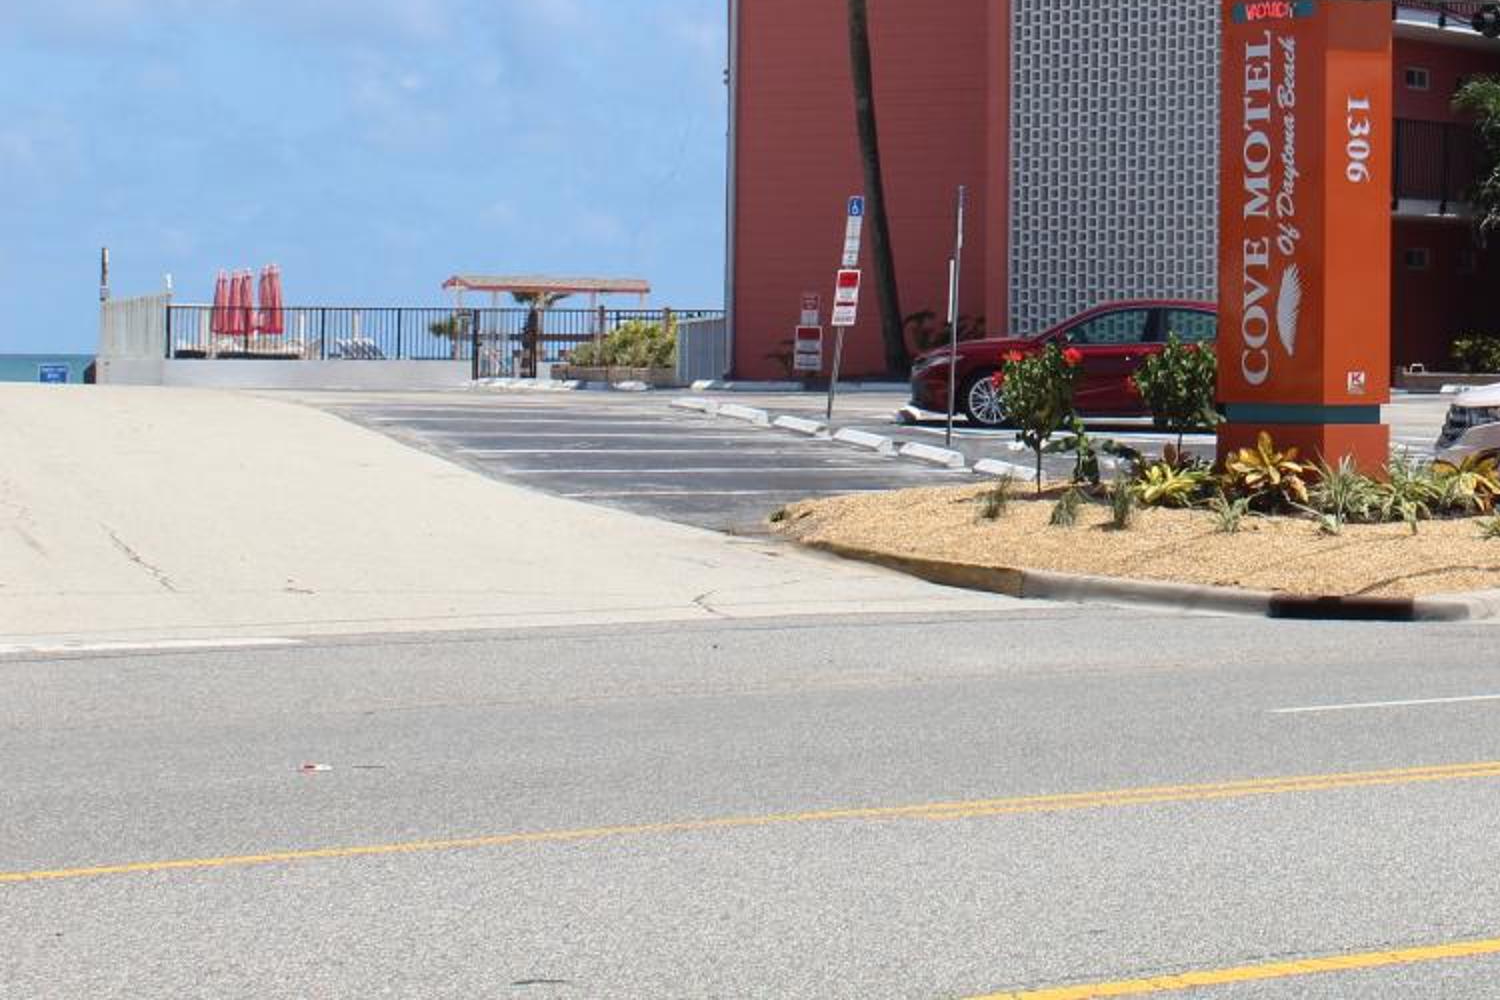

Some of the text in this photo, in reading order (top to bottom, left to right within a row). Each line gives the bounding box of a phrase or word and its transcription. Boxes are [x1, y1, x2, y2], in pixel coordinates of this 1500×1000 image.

[1242, 29, 1271, 385] COVE MOTEL
[1276, 34, 1300, 255] Of Daytona Beach
[1346, 94, 1371, 183] 1306
